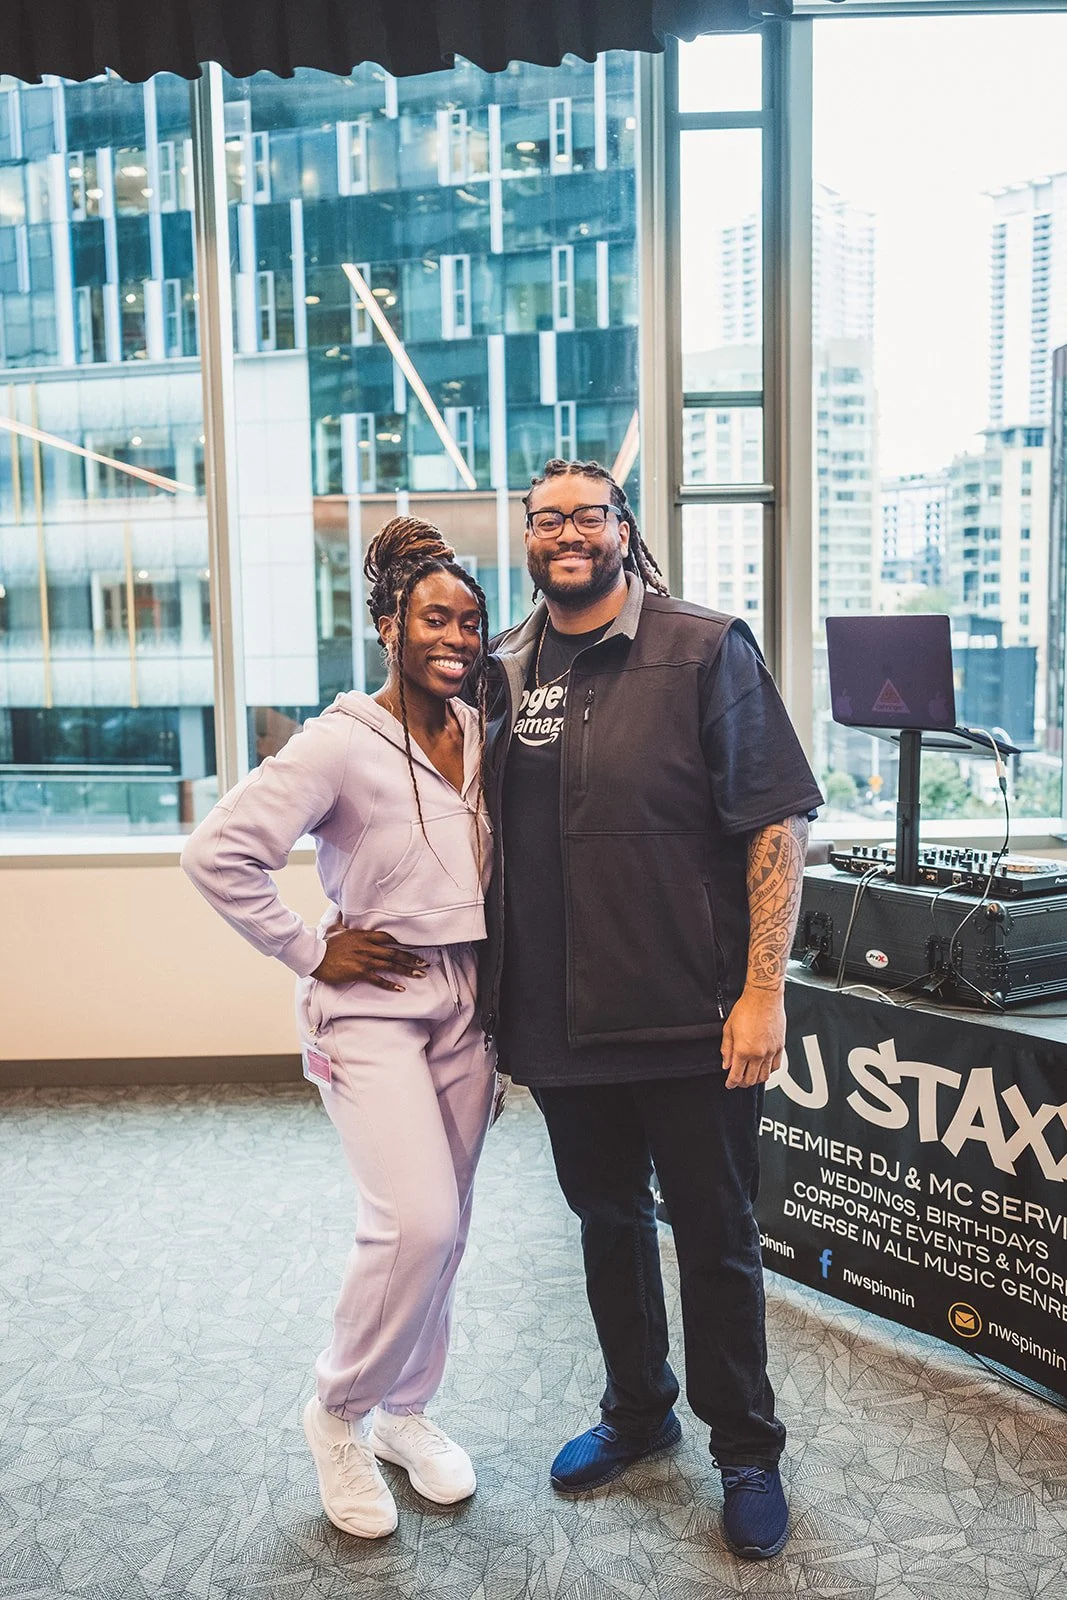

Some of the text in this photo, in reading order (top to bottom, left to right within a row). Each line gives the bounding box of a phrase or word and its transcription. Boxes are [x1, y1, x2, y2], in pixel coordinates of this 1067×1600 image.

[513, 717, 564, 734] amaz
[846, 1038, 1067, 1182] STAX
[758, 1116, 863, 1170] PREMIER
[870, 1152, 900, 1182] DJ
[904, 1167, 922, 1191] &
[929, 1173, 974, 1206] MC
[783, 1199, 859, 1242] DIVERSE
[862, 1229, 880, 1250] IN
[883, 1239, 920, 1265] ALL
[925, 1252, 996, 1289] MUSIC
[793, 1181, 1067, 1297] CORPORATE EVENTS & MOR
[820, 1167, 1049, 1260] WEDDINGS, BIRTHDAYS
[843, 1268, 915, 1308] nwspinnin
[988, 1321, 1067, 1371] nwspinnin
